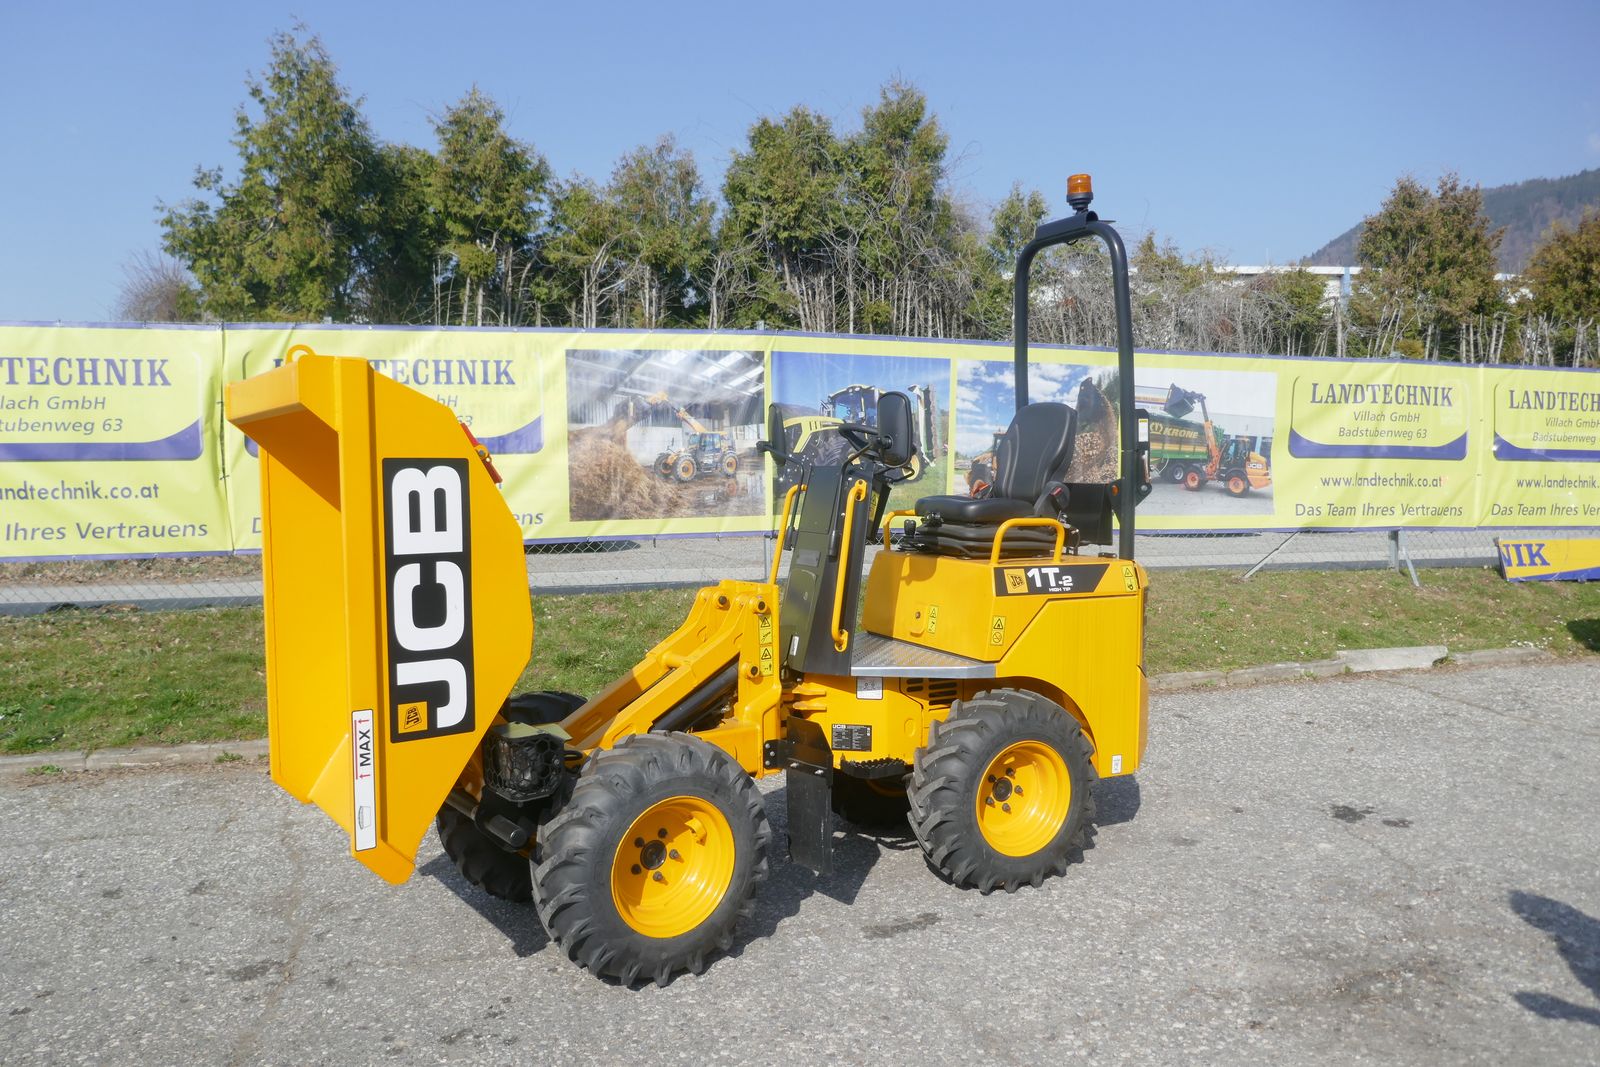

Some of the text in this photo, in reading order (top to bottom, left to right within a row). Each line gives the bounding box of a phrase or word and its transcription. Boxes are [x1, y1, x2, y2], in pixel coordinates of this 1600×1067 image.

[47, 395, 106, 410] GmbH
[1310, 383, 1453, 407] LANDTECHNIK
[1353, 411, 1420, 423] Villach GmbH
[1545, 417, 1573, 428] Villach
[102, 418, 123, 432] 63
[1163, 428, 1199, 439] KRONE
[1338, 427, 1427, 440] Badstubenweg 63
[1533, 432, 1596, 445] Badstubenweg
[1320, 472, 1442, 488] www.landtechnik.co.at
[0, 480, 159, 500] ndtechnik.co.at
[1295, 502, 1463, 517] Das Team Ihres Vertrauens
[1491, 503, 1513, 516] Das
[1518, 504, 1546, 516] Team
[1550, 503, 1578, 516] Ihres
[6, 521, 208, 541] Ihres Vertrauens
[392, 465, 467, 729] JCB
[406, 707, 420, 725] JCB
[359, 729, 371, 767] MAX
